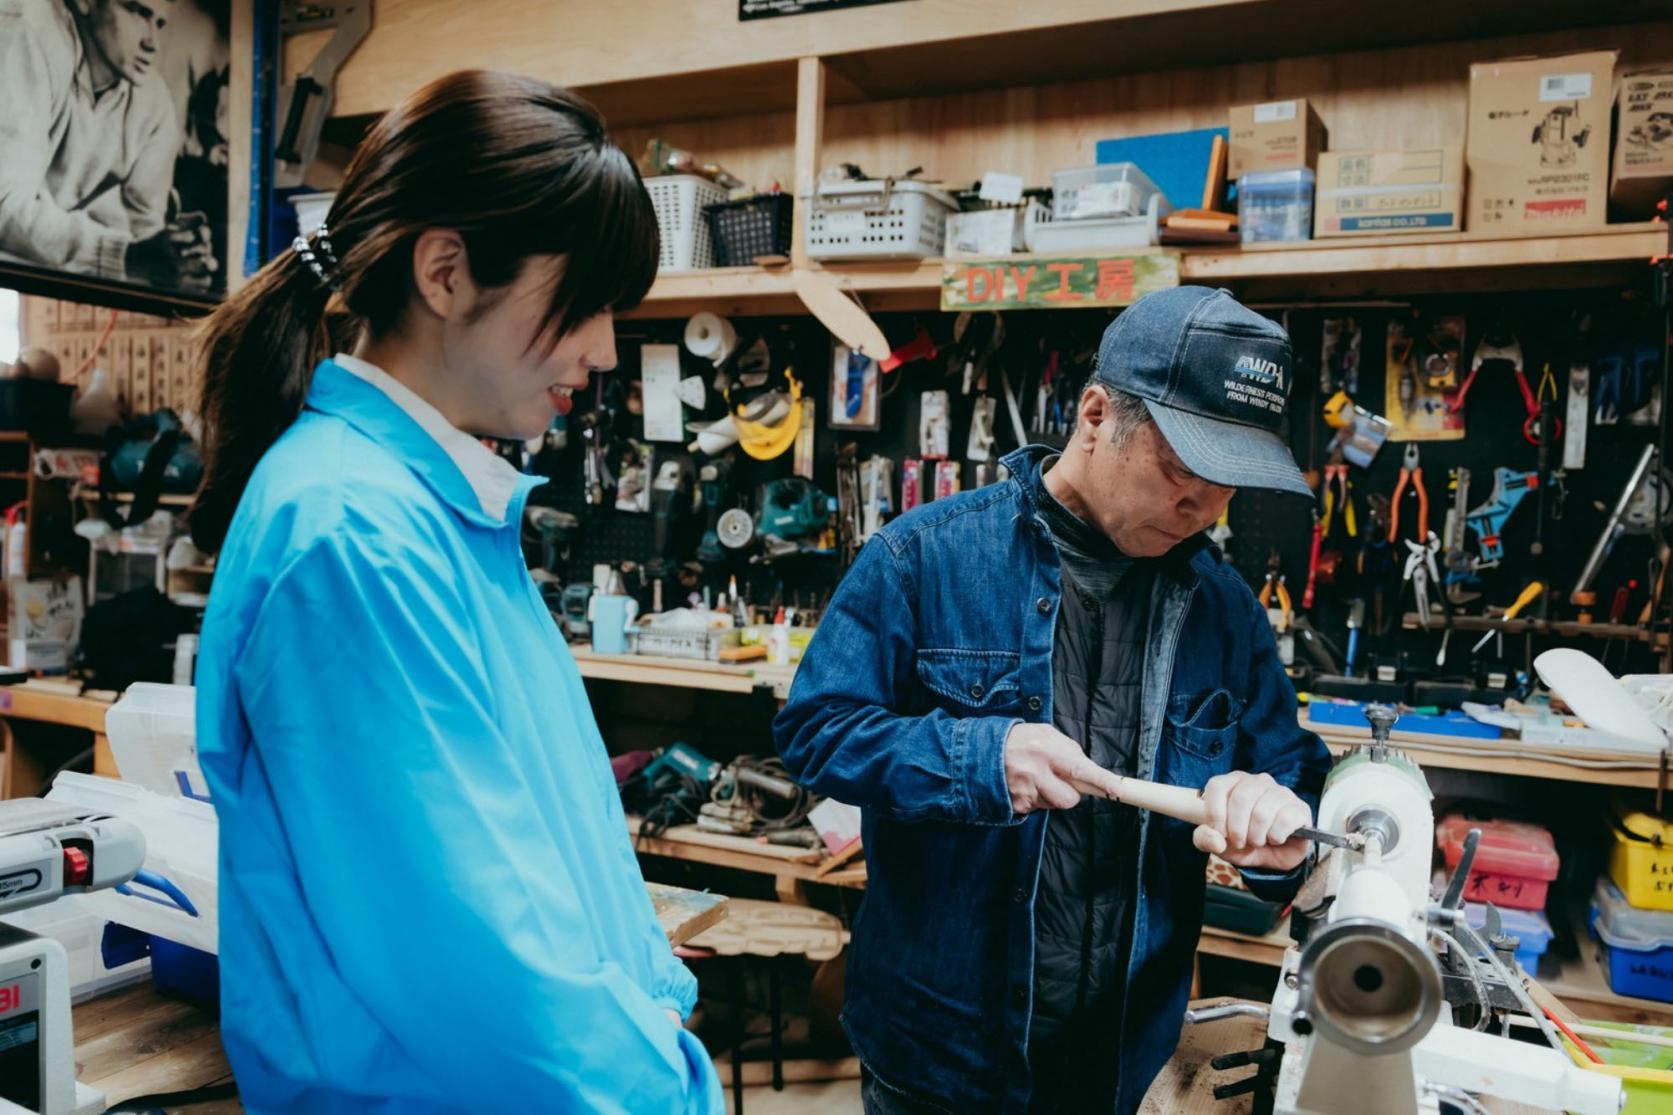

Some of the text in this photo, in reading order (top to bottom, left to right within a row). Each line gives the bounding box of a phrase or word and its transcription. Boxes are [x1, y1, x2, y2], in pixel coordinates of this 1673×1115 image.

[965, 265, 1037, 303] DIY
[1224, 379, 1266, 398] WILDERNESS
[1226, 390, 1249, 403] FROM
